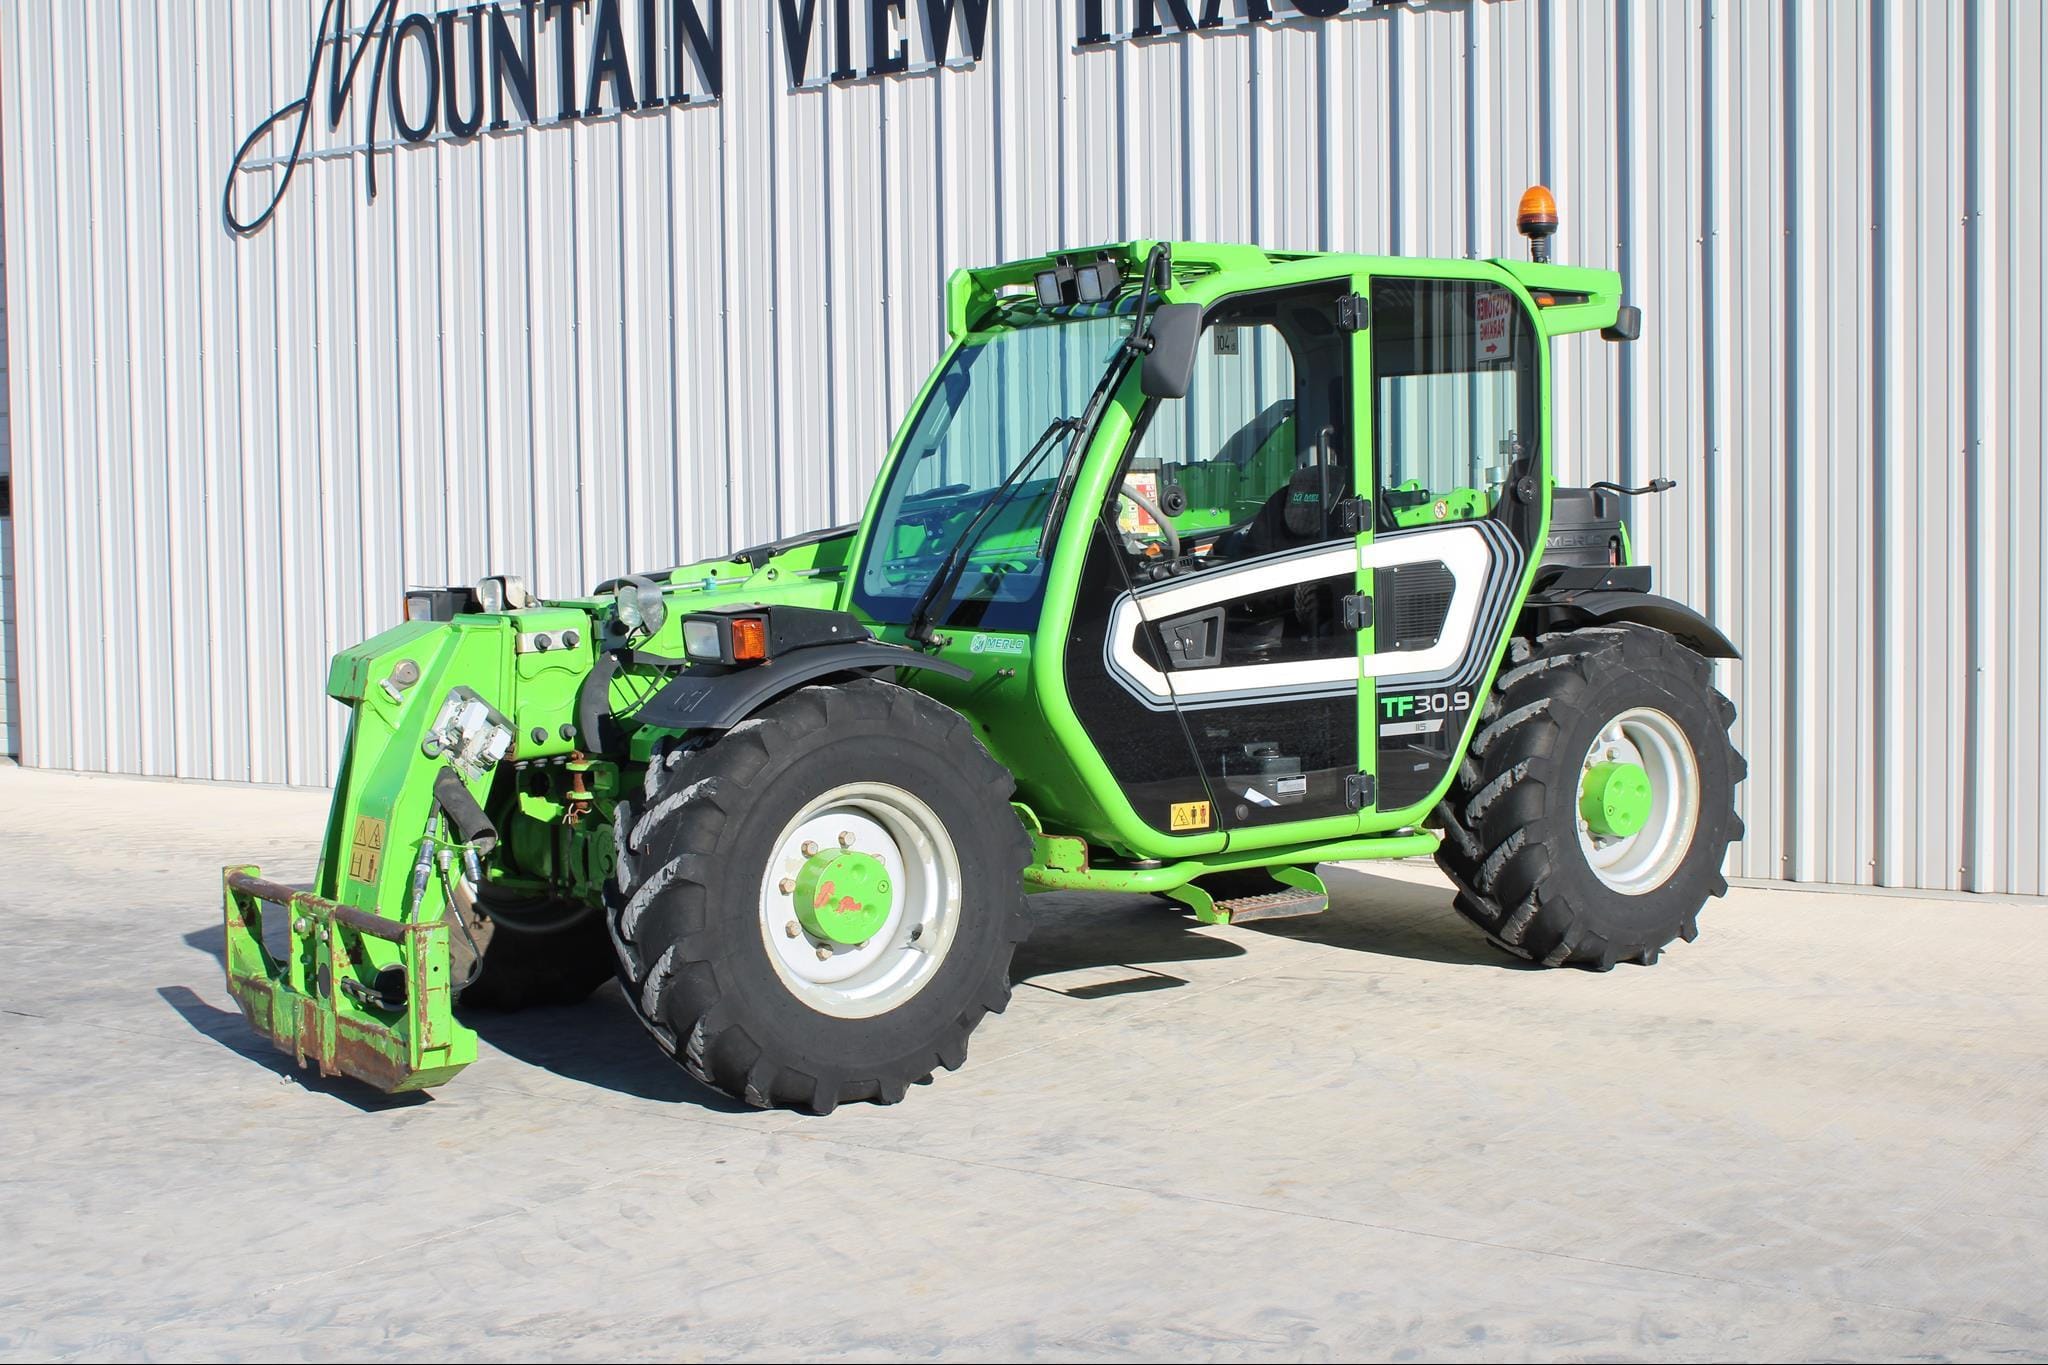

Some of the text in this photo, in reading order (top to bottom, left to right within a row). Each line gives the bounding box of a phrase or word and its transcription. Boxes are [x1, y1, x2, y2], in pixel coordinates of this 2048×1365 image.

[1217, 335, 1230, 351] 104
[1546, 535, 1602, 547] MERLO
[986, 637, 1024, 650] MERLO
[1380, 691, 1470, 718] TF30.9
